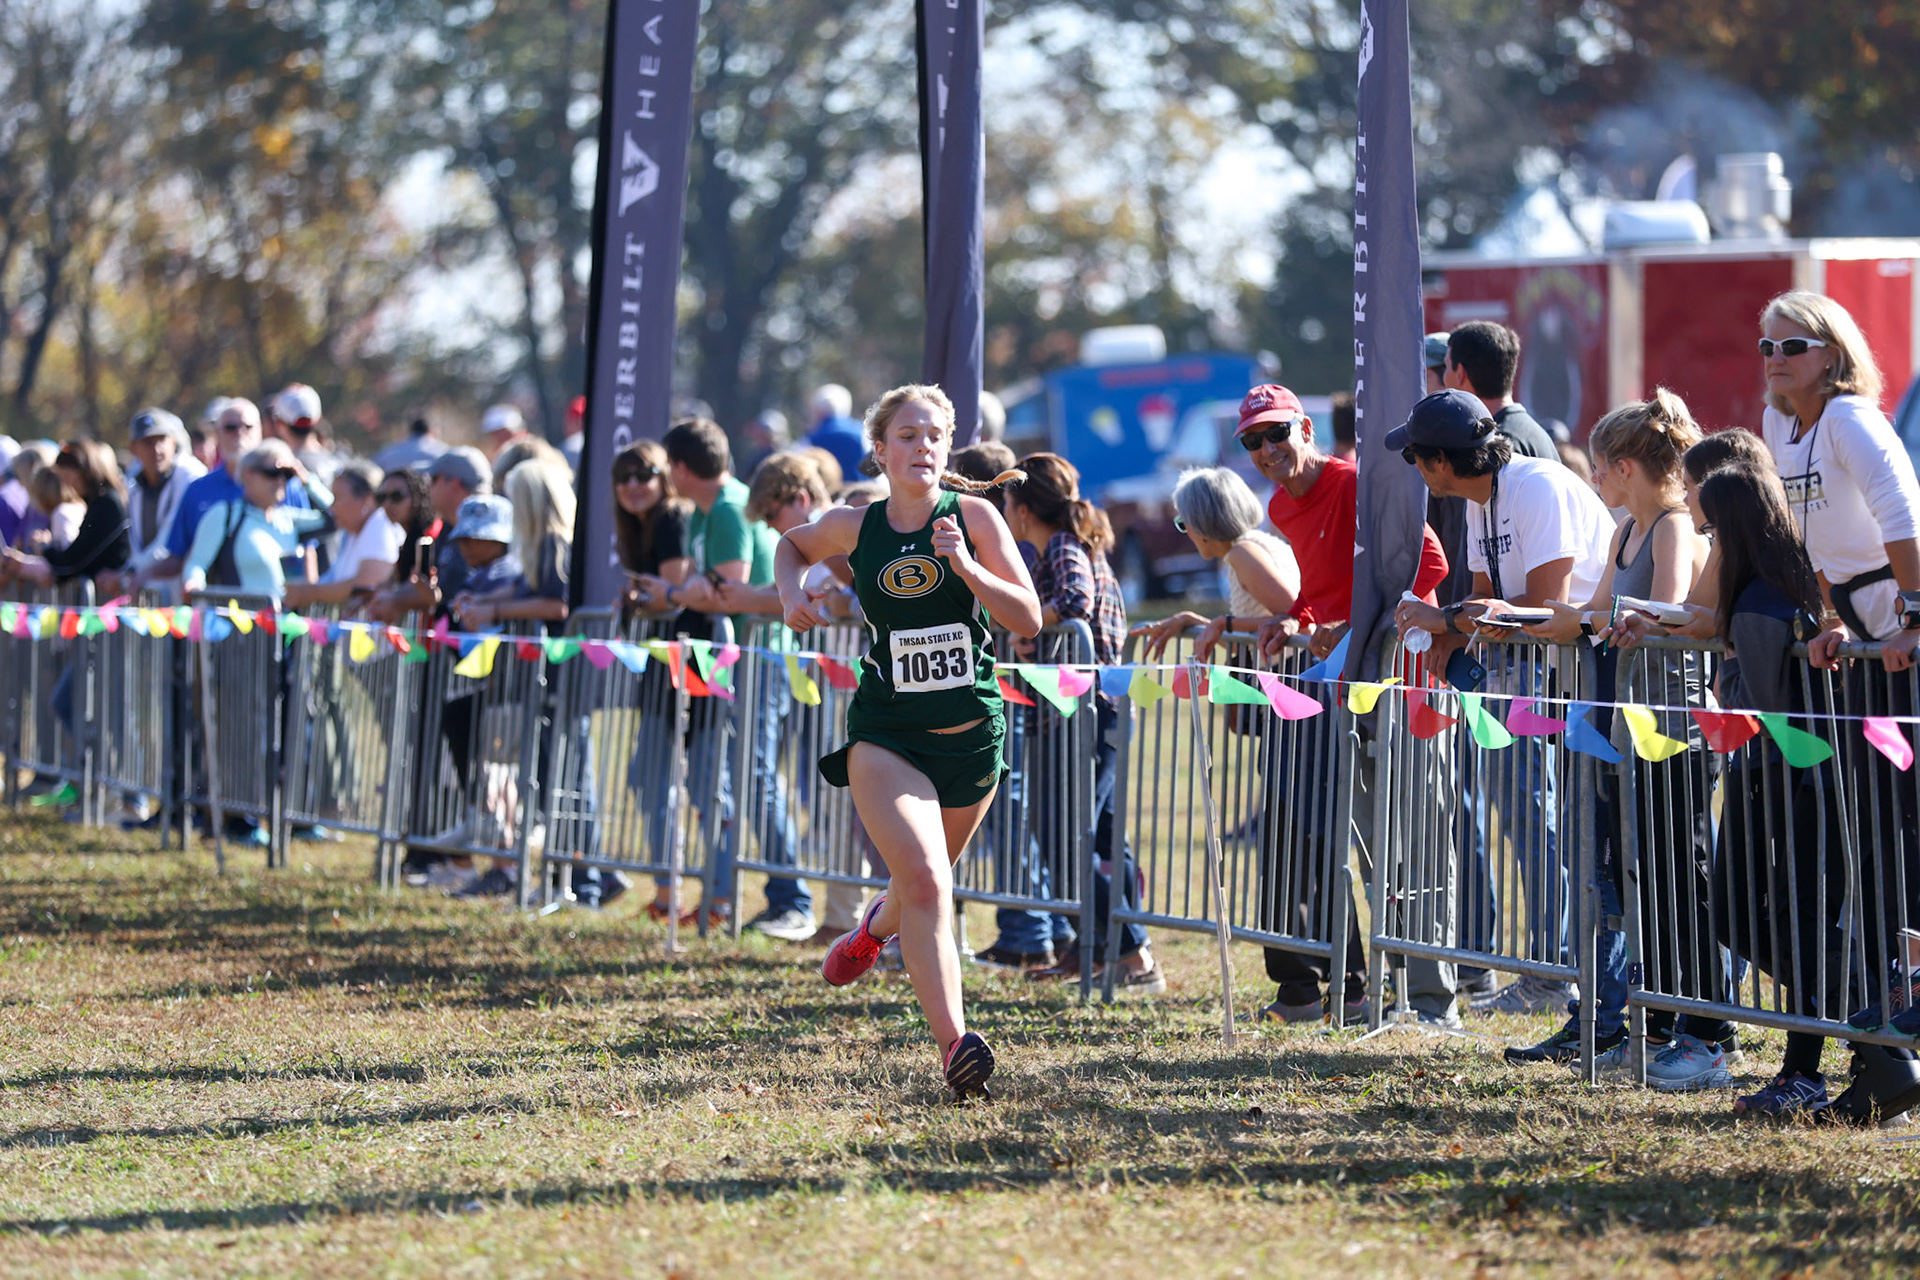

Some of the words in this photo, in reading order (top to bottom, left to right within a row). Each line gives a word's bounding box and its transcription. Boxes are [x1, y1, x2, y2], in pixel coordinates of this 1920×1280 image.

[635, 0, 664, 119] HEA
[898, 636, 927, 647] TMSAA
[927, 633, 951, 645] STATE
[952, 631, 964, 641] XC
[897, 647, 969, 683] 1033
